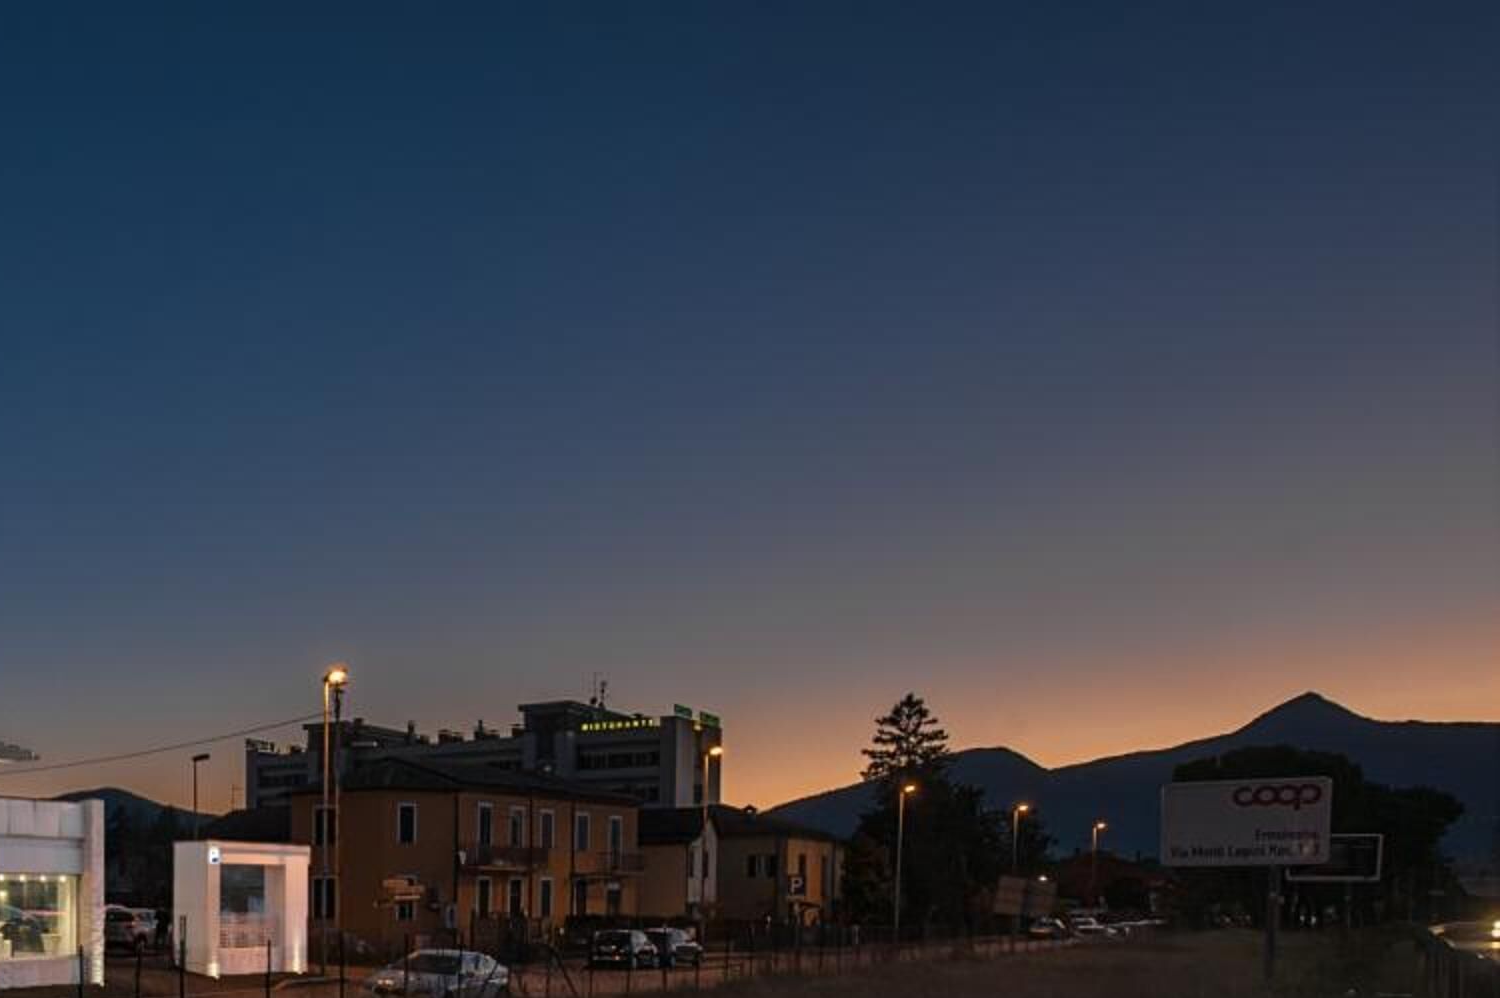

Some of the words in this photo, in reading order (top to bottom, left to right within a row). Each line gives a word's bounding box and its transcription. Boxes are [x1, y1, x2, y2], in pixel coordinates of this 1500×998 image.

[581, 719, 654, 732] RISTORANTE
[1233, 784, 1322, 810] coop
[790, 876, 804, 893] P
